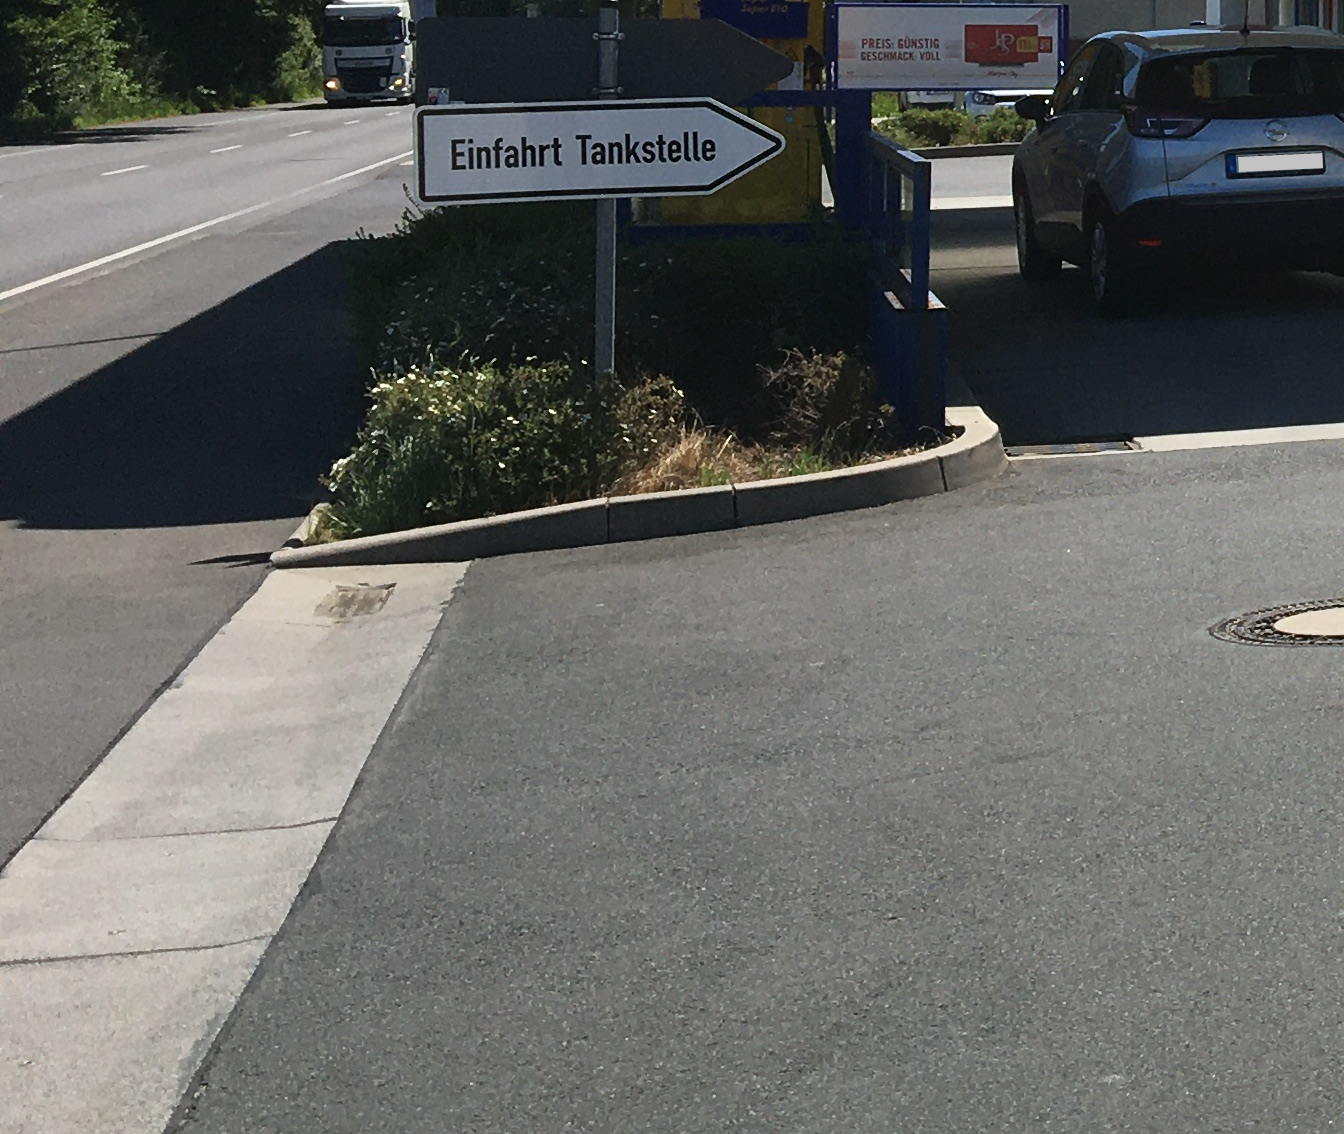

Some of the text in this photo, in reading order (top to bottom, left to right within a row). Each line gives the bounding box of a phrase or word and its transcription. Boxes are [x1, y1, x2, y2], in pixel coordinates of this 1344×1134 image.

[861, 36, 940, 49] PREIS: GÜNSTIG
[919, 52, 941, 62] VOLL
[451, 132, 716, 170] Einfahrt Tankstelle
